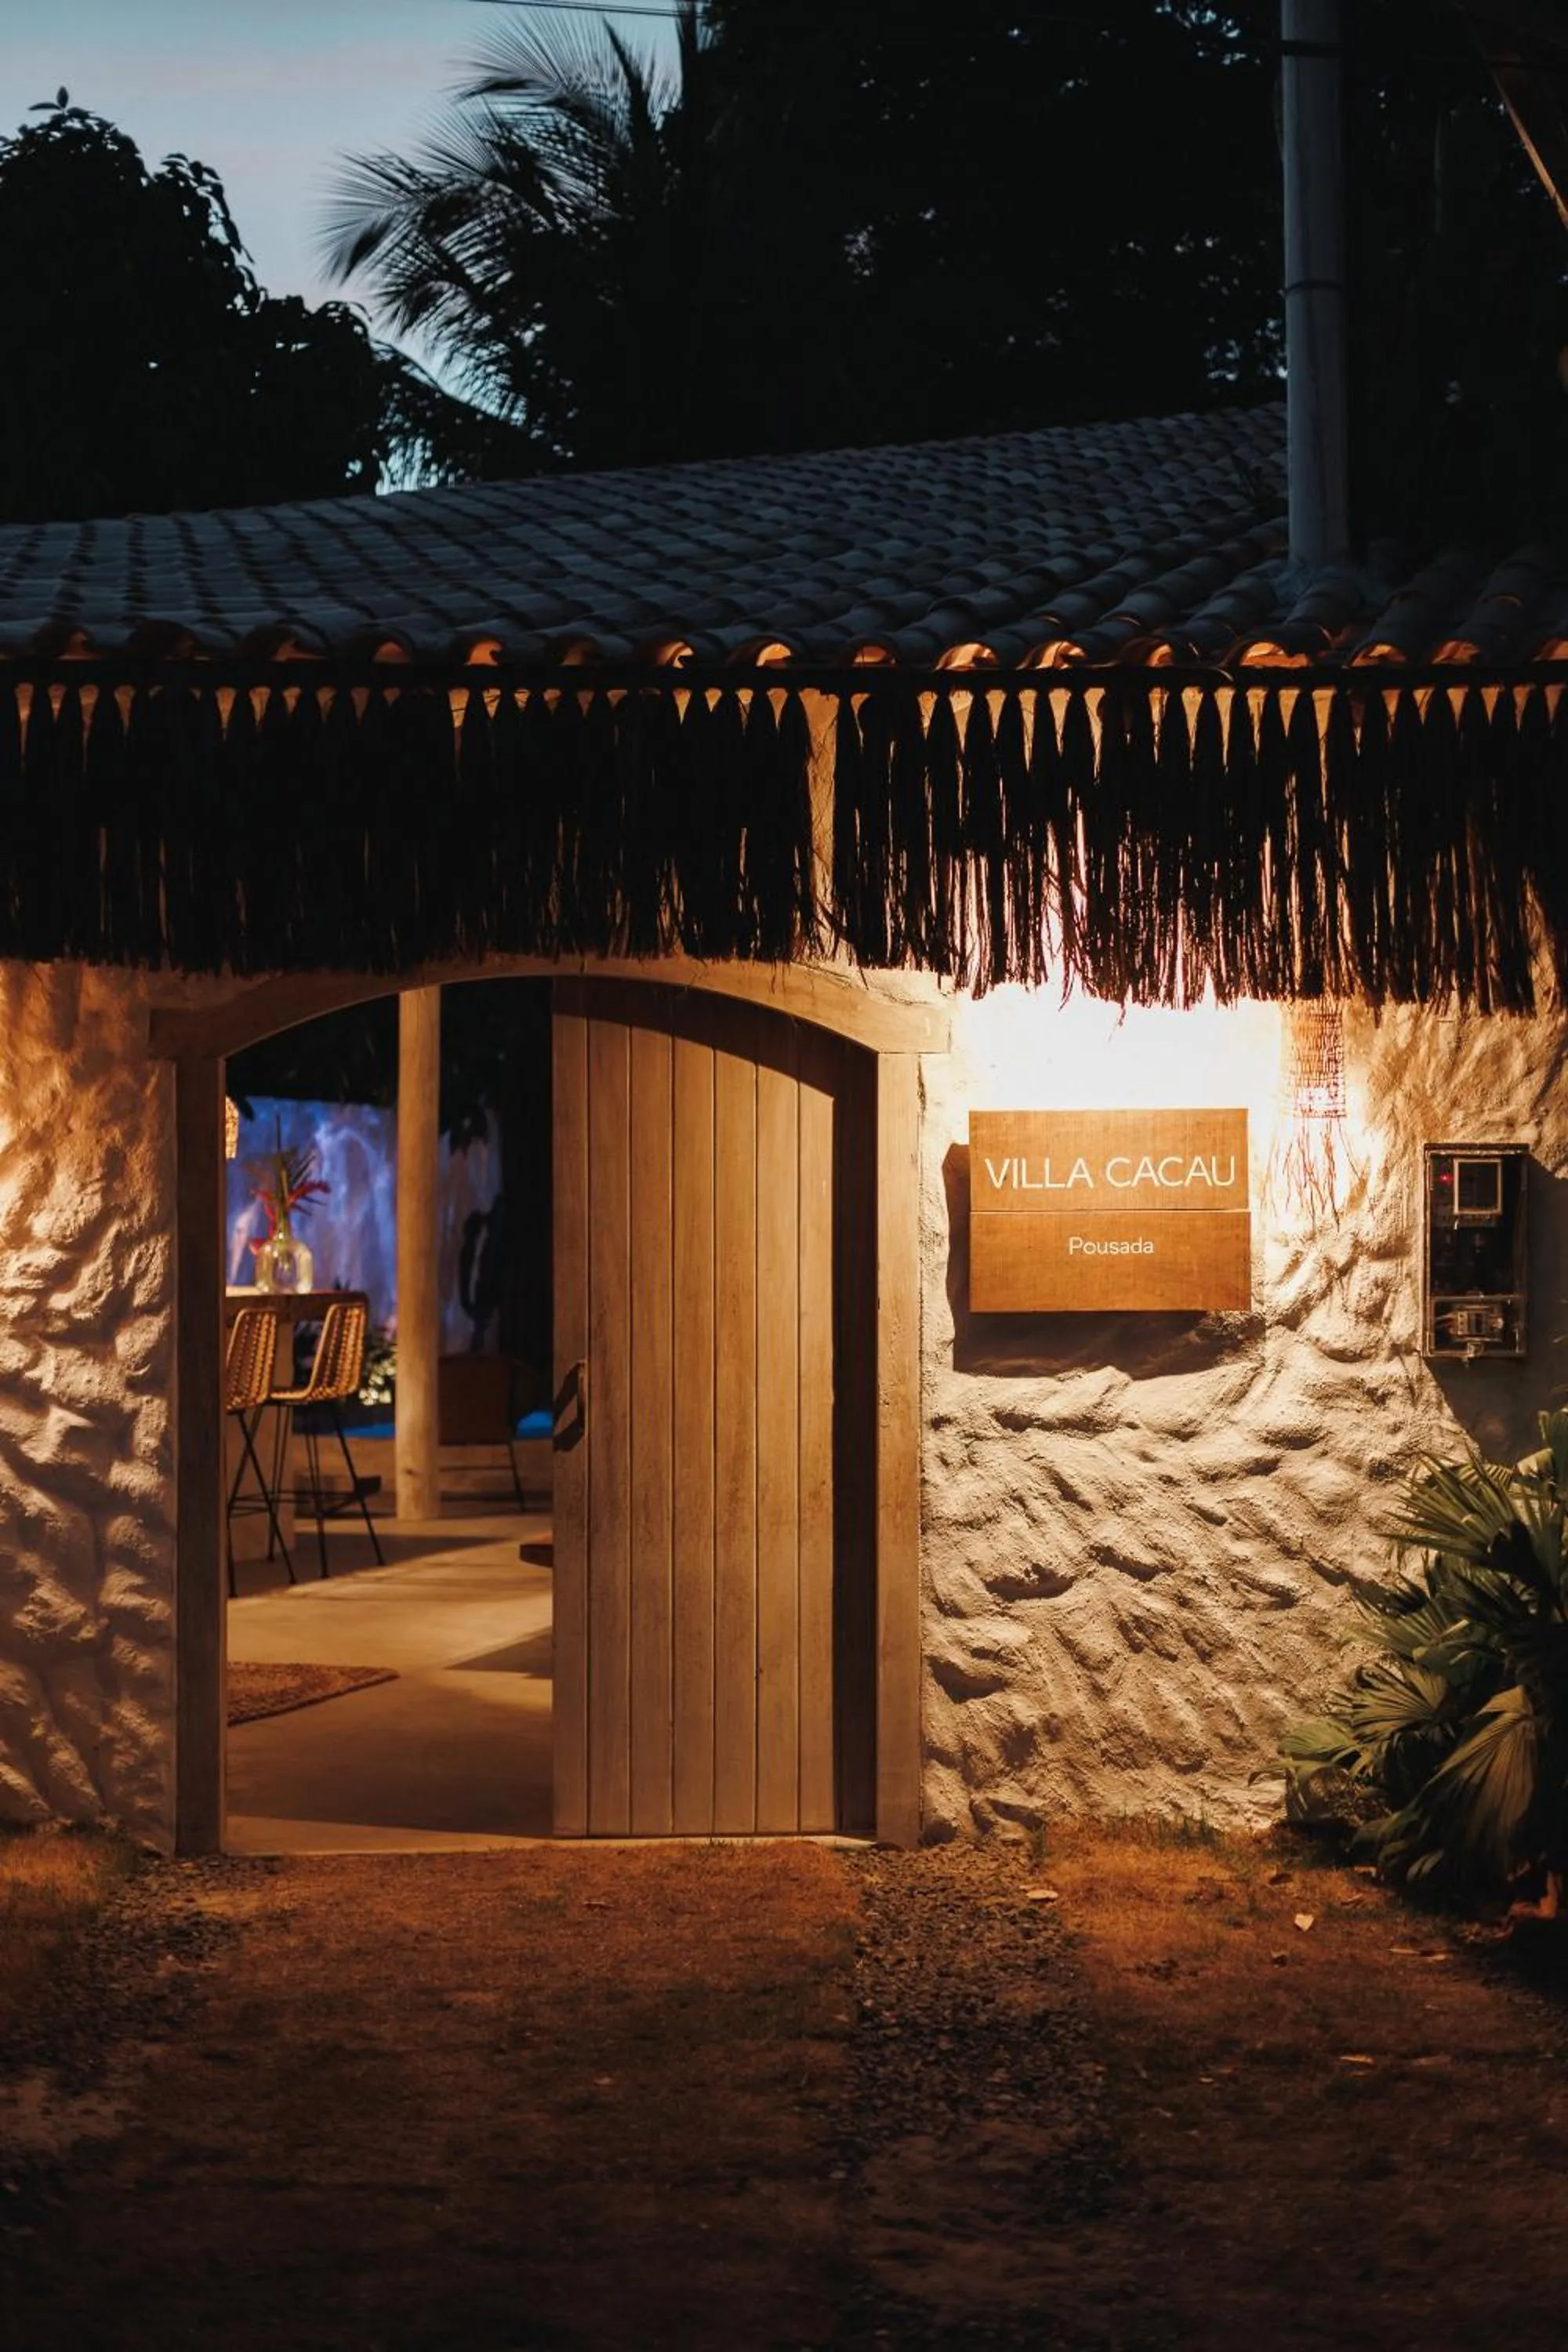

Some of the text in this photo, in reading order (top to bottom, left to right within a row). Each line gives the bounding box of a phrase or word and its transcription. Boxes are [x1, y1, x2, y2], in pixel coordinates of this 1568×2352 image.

[984, 1155, 1236, 1189] VILLA CACAU
[1069, 1237, 1155, 1254] Pousada
